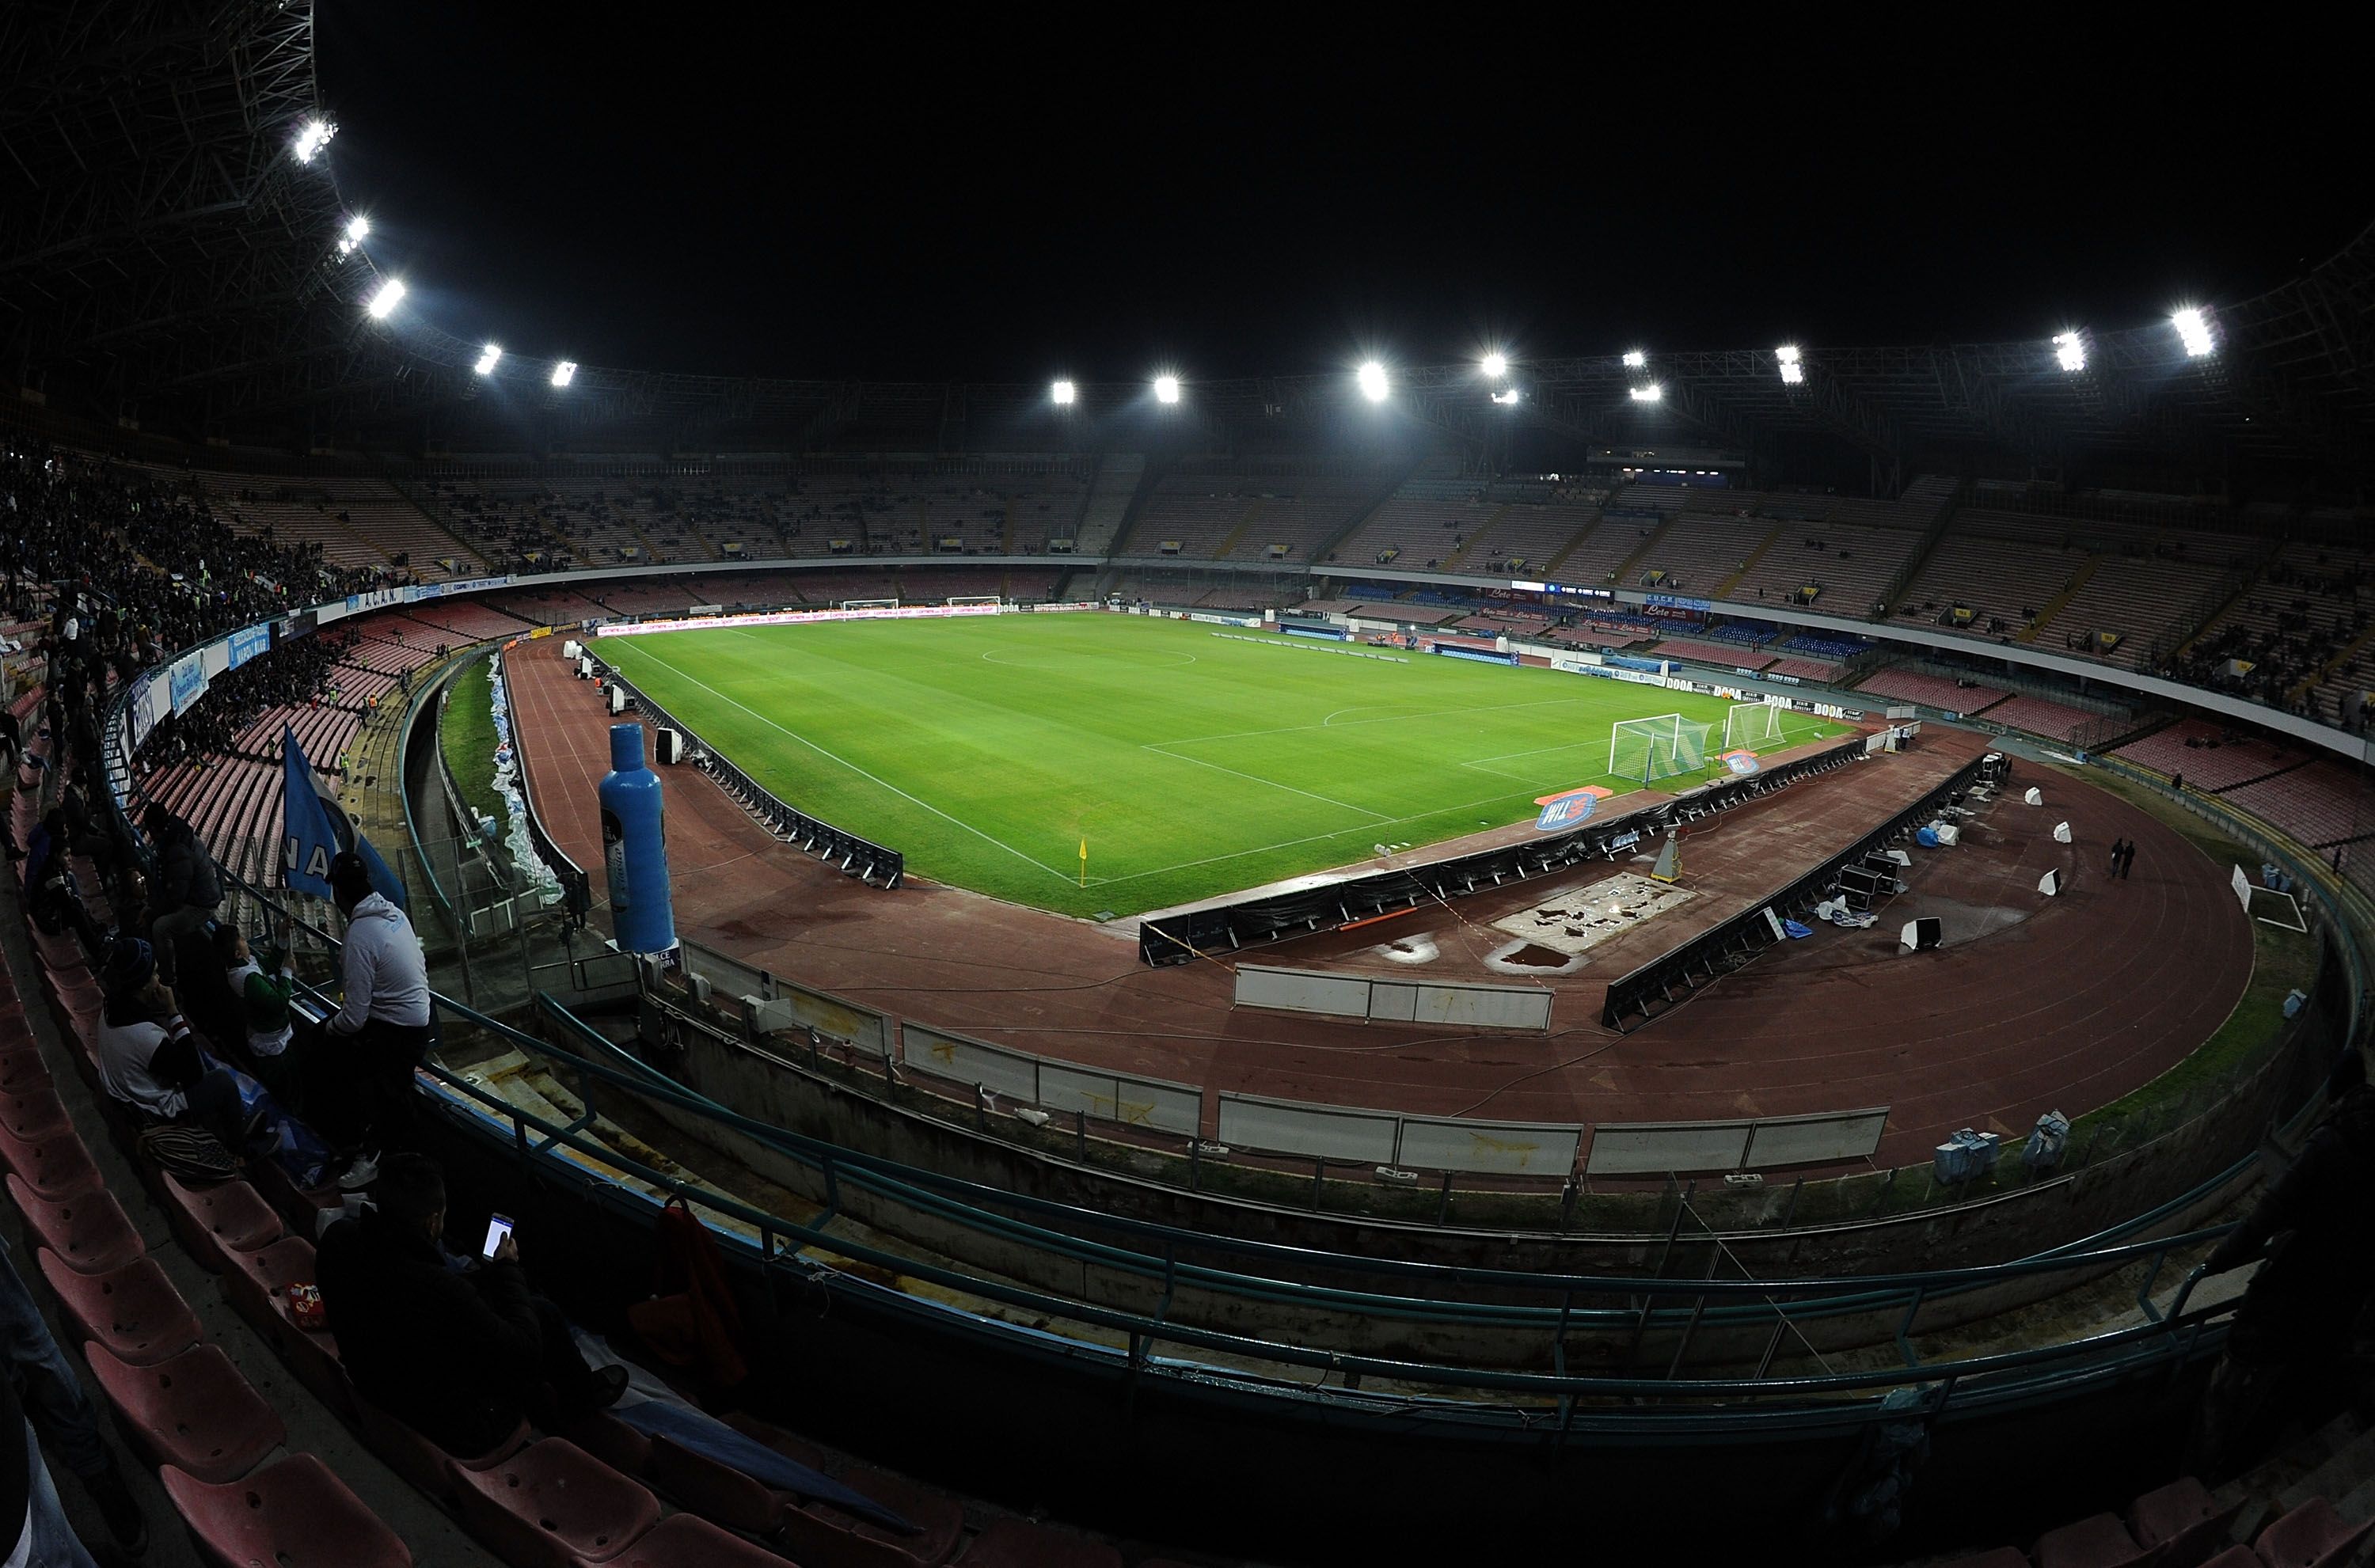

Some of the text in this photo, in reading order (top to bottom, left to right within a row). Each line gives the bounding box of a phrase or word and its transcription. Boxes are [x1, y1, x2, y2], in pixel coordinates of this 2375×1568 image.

[1644, 605, 1670, 617] Lete
[1666, 678, 1693, 692] DOOA
[1764, 694, 1792, 710] DOOA
[1814, 702, 1843, 719] DOOA
[1541, 800, 1571, 825] TIM
